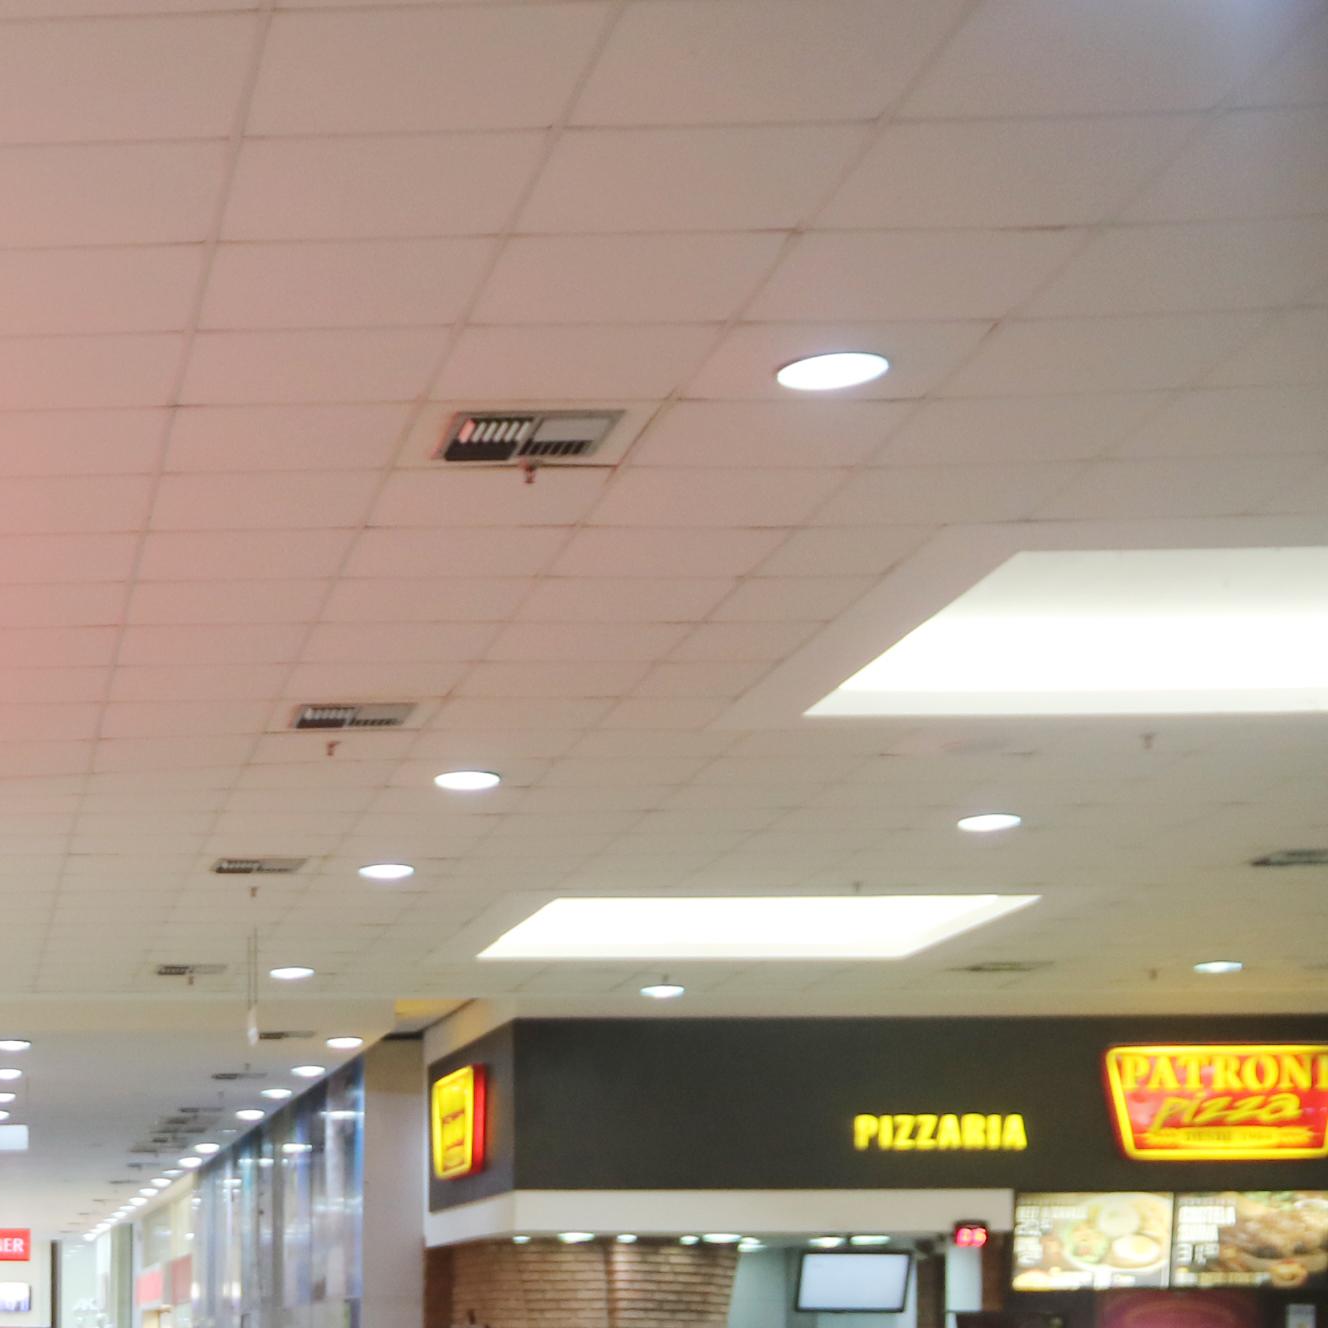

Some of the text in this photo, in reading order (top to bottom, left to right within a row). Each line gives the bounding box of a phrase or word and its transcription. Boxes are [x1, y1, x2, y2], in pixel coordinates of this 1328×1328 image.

[1120, 1054, 1328, 1091] PATRONI
[1150, 1091, 1302, 1134] pizza
[854, 1113, 1028, 1150] PIZZARIA
